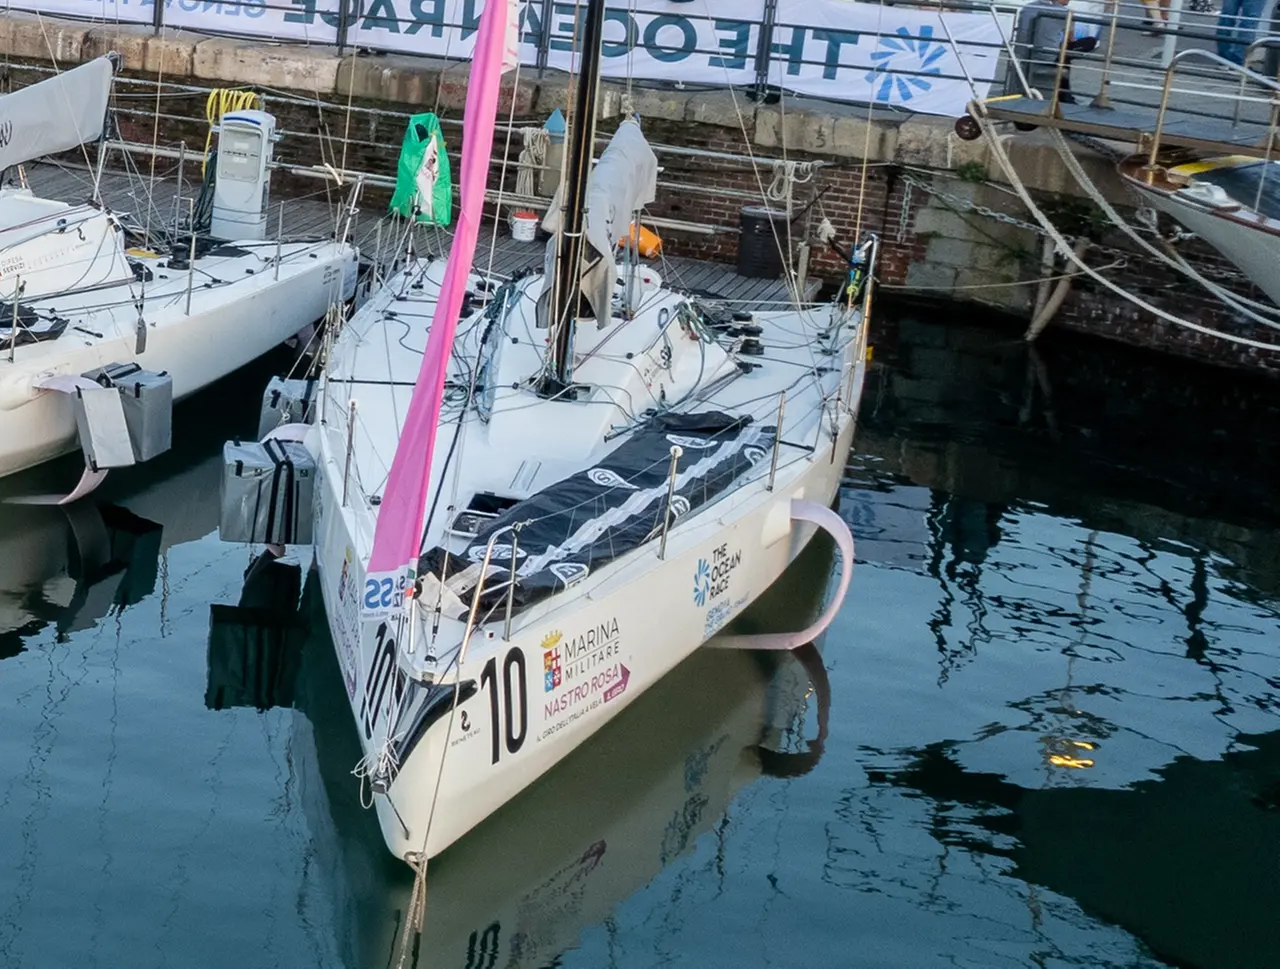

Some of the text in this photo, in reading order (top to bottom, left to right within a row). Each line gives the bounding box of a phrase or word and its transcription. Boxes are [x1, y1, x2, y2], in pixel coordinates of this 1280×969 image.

[711, 549, 742, 582] OCEAN
[713, 542, 727, 563] THE
[709, 575, 730, 600] RACE
[564, 617, 620, 662] MARINA
[565, 641, 620, 681] MILITARE
[480, 646, 528, 765] 10
[544, 663, 620, 721] NASTRO ROSA
